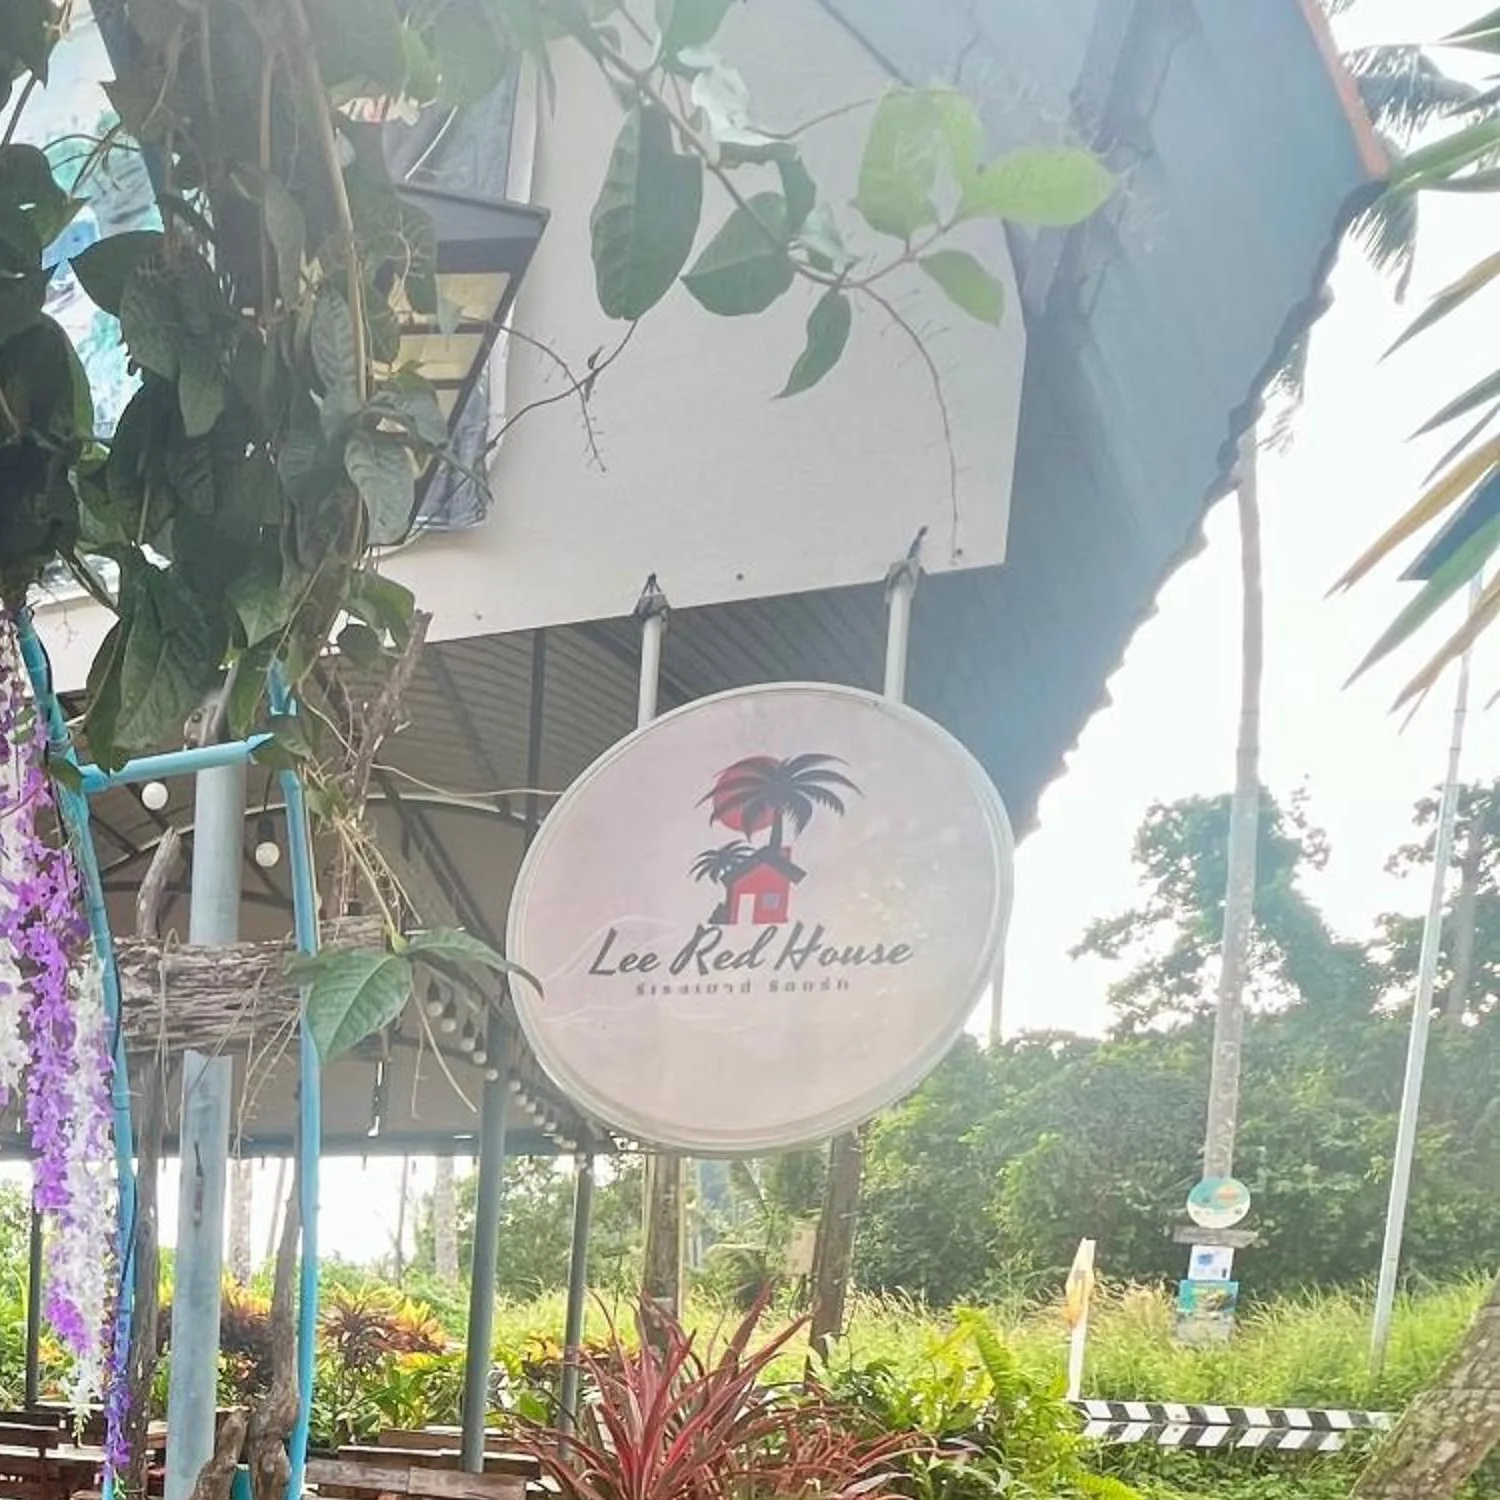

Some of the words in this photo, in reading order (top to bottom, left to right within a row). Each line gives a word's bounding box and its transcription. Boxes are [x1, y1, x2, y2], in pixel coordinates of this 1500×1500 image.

[588, 926, 661, 976] Lee
[669, 923, 778, 976] Red
[773, 921, 915, 972] House
